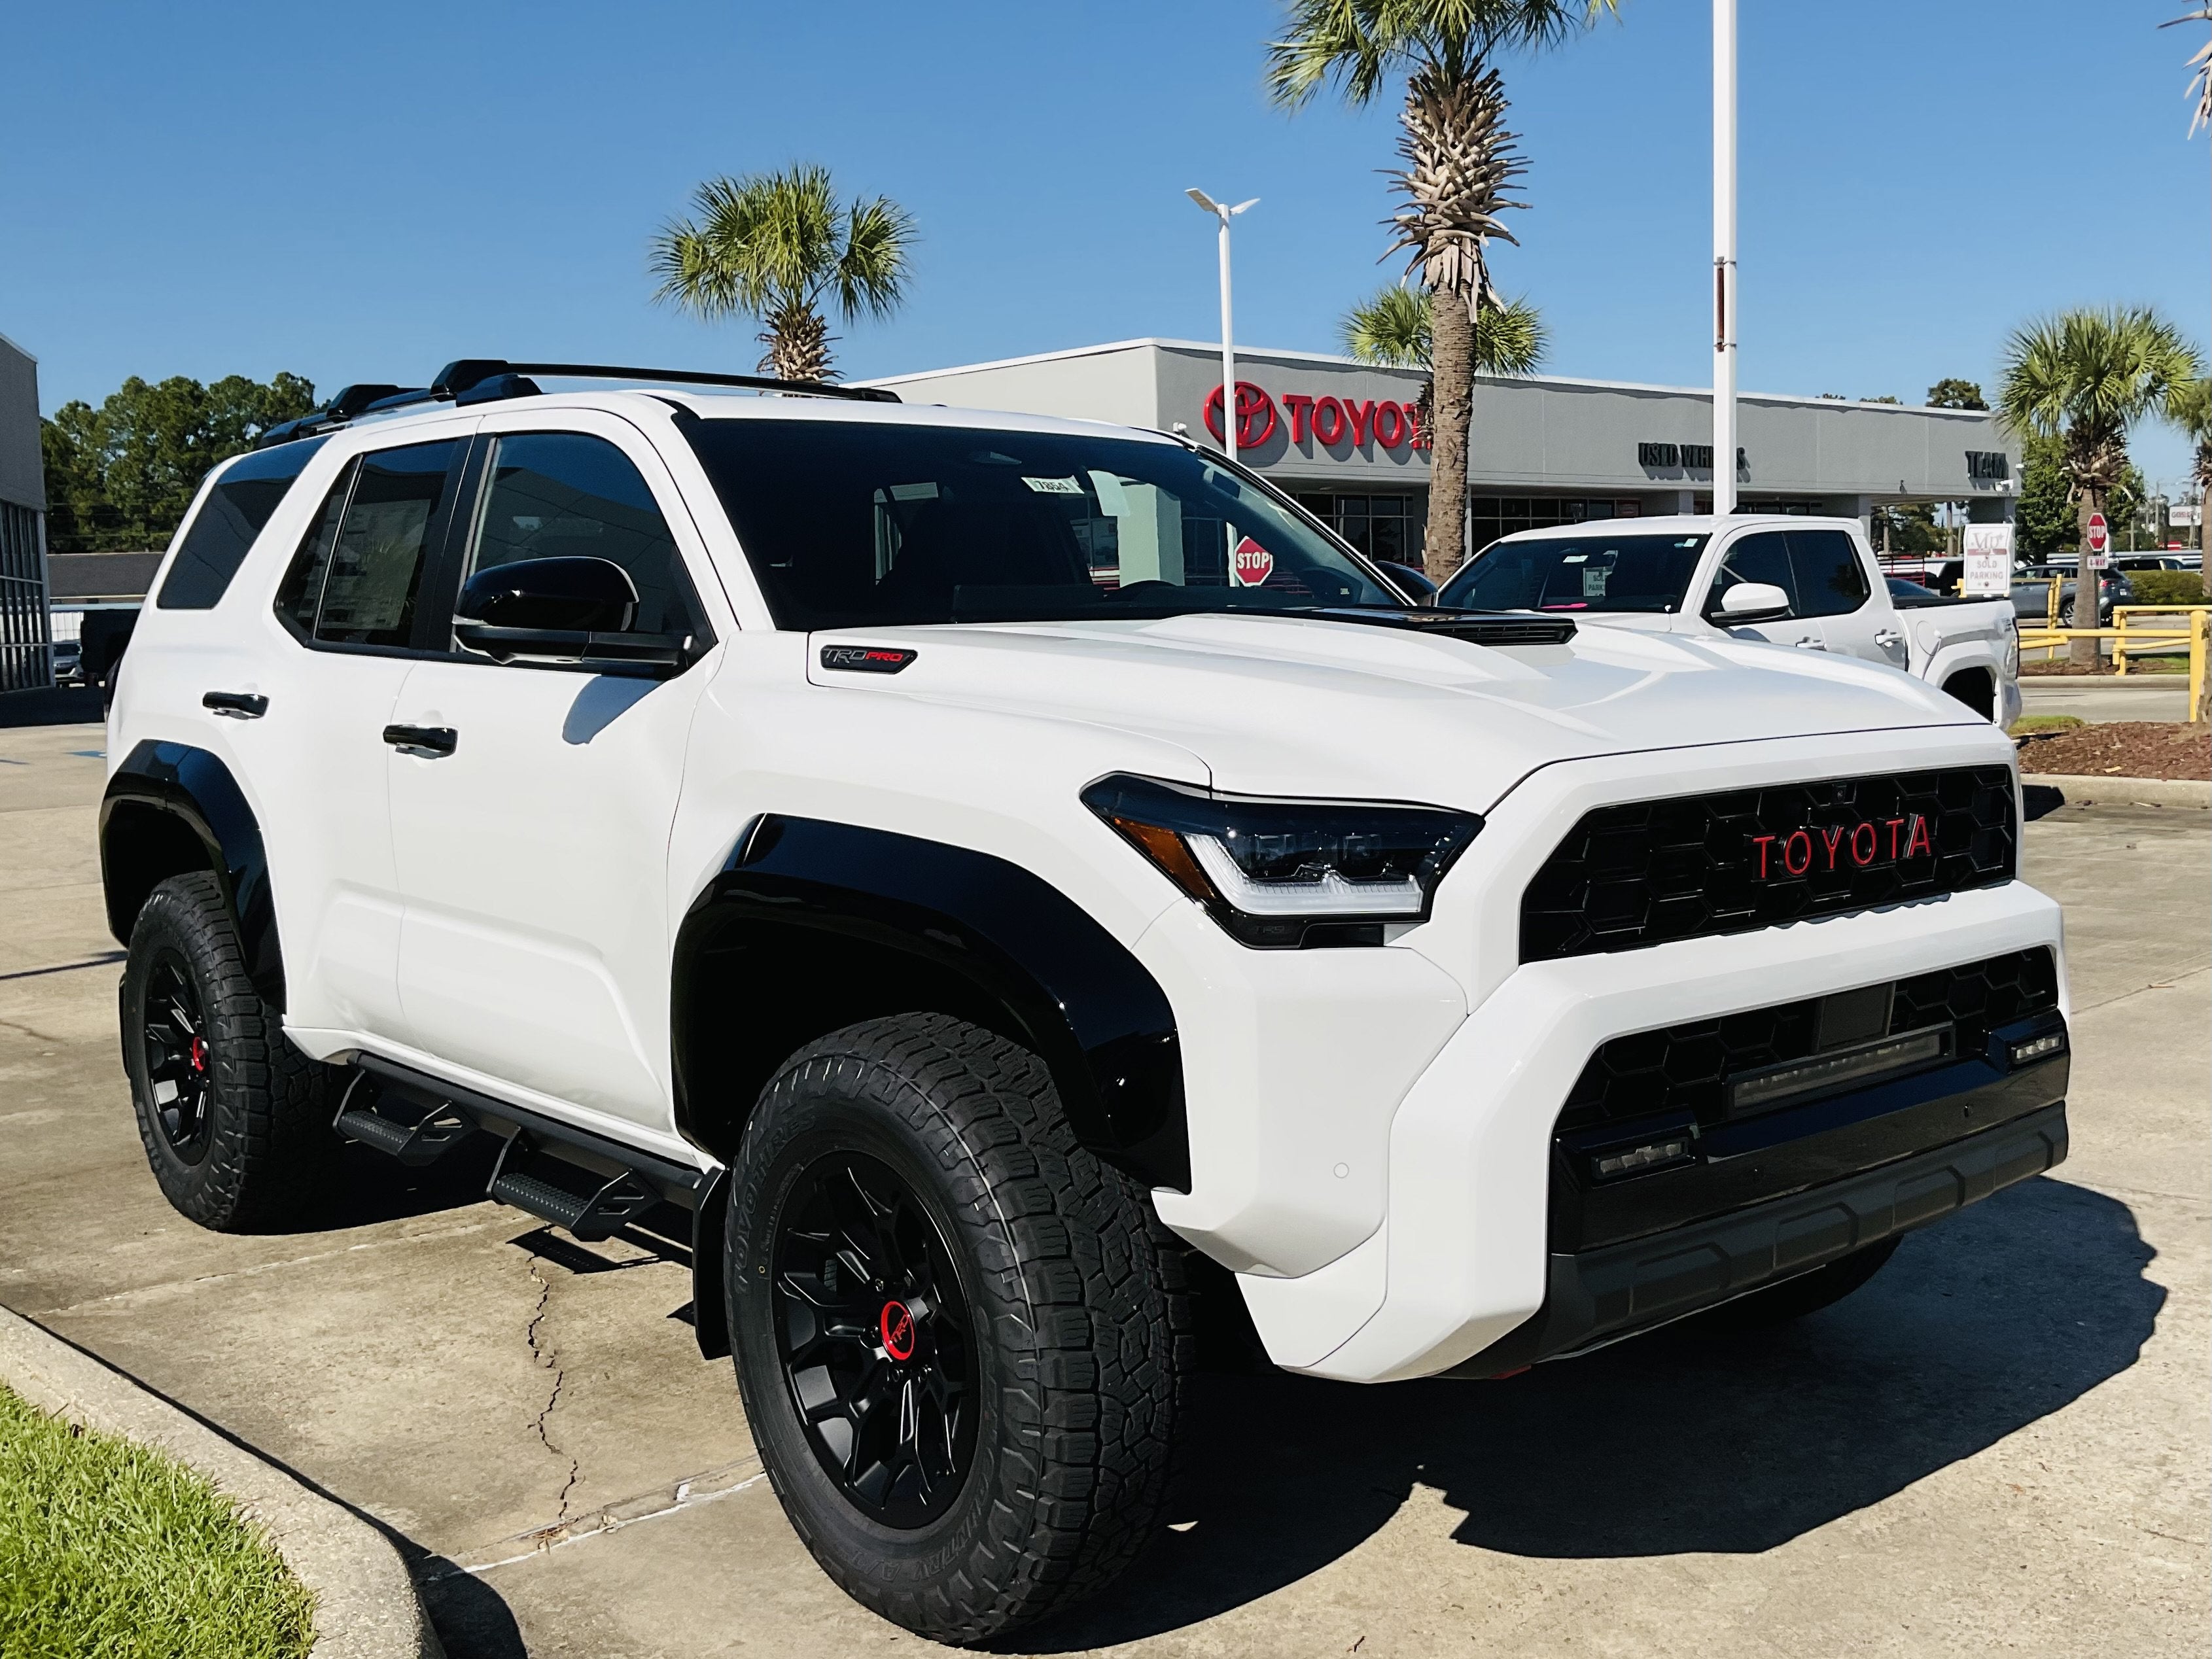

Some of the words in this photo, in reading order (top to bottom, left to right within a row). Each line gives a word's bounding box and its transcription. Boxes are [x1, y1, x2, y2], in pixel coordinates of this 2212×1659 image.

[1282, 394, 1434, 450] TOYOT
[1638, 442, 1679, 467] USED
[1965, 451, 2009, 479] TEAM
[2088, 525, 2106, 538] STOP
[1237, 551, 1270, 569] STOP
[1976, 560, 1997, 568] SOLD
[2089, 558, 2106, 567] 4-WAY
[1970, 571, 2003, 580] PARKING
[823, 648, 868, 663] TRD
[865, 651, 904, 662] PRO
[1752, 815, 1931, 879] TOYOTA
